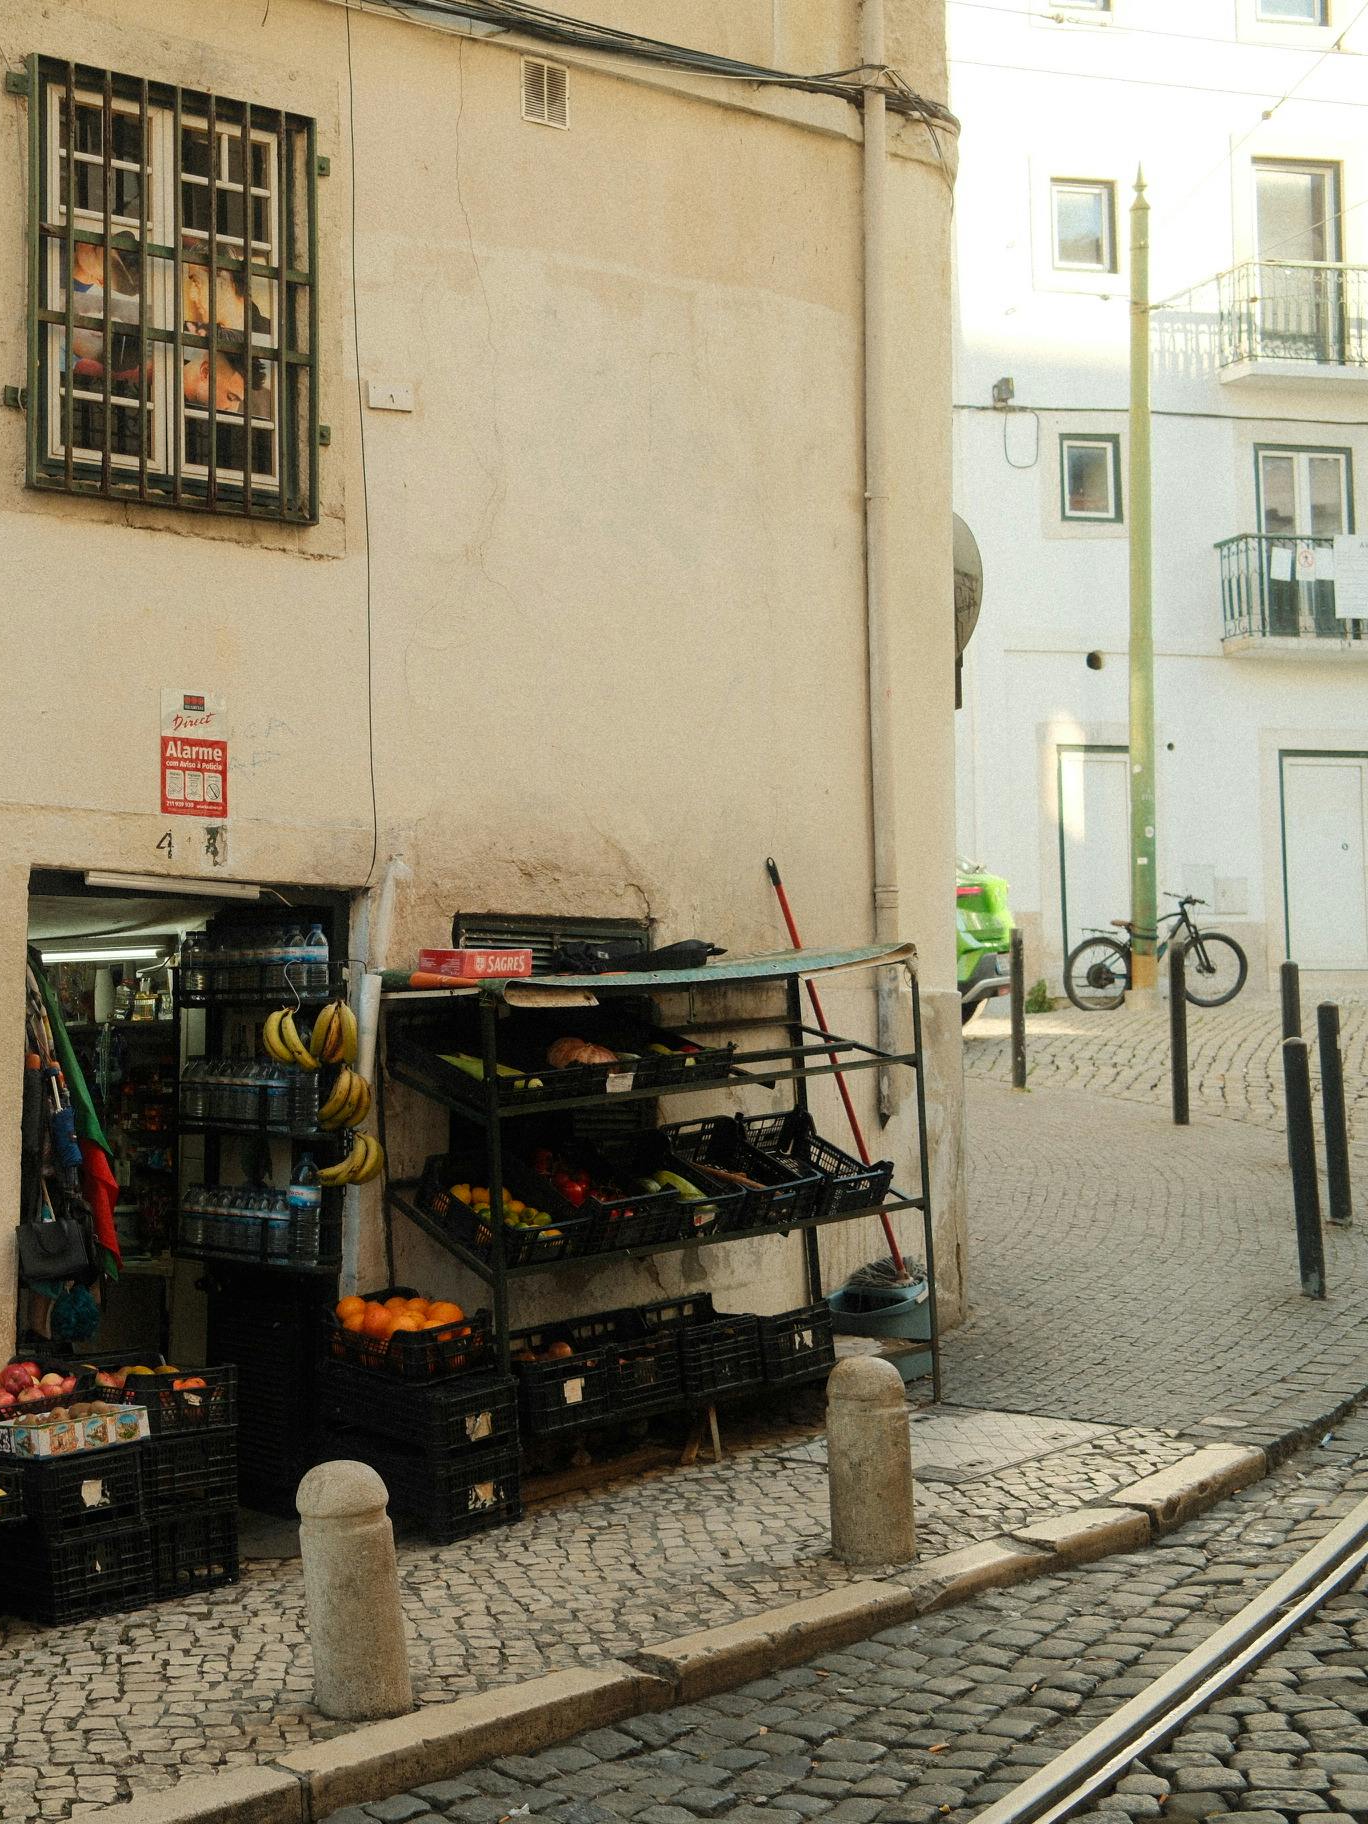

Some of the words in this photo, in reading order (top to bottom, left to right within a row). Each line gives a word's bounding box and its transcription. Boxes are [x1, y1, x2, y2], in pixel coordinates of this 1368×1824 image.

[172, 712, 216, 731] Direct
[166, 741, 223, 762] Alarme
[487, 955, 525, 973] SAGRES
